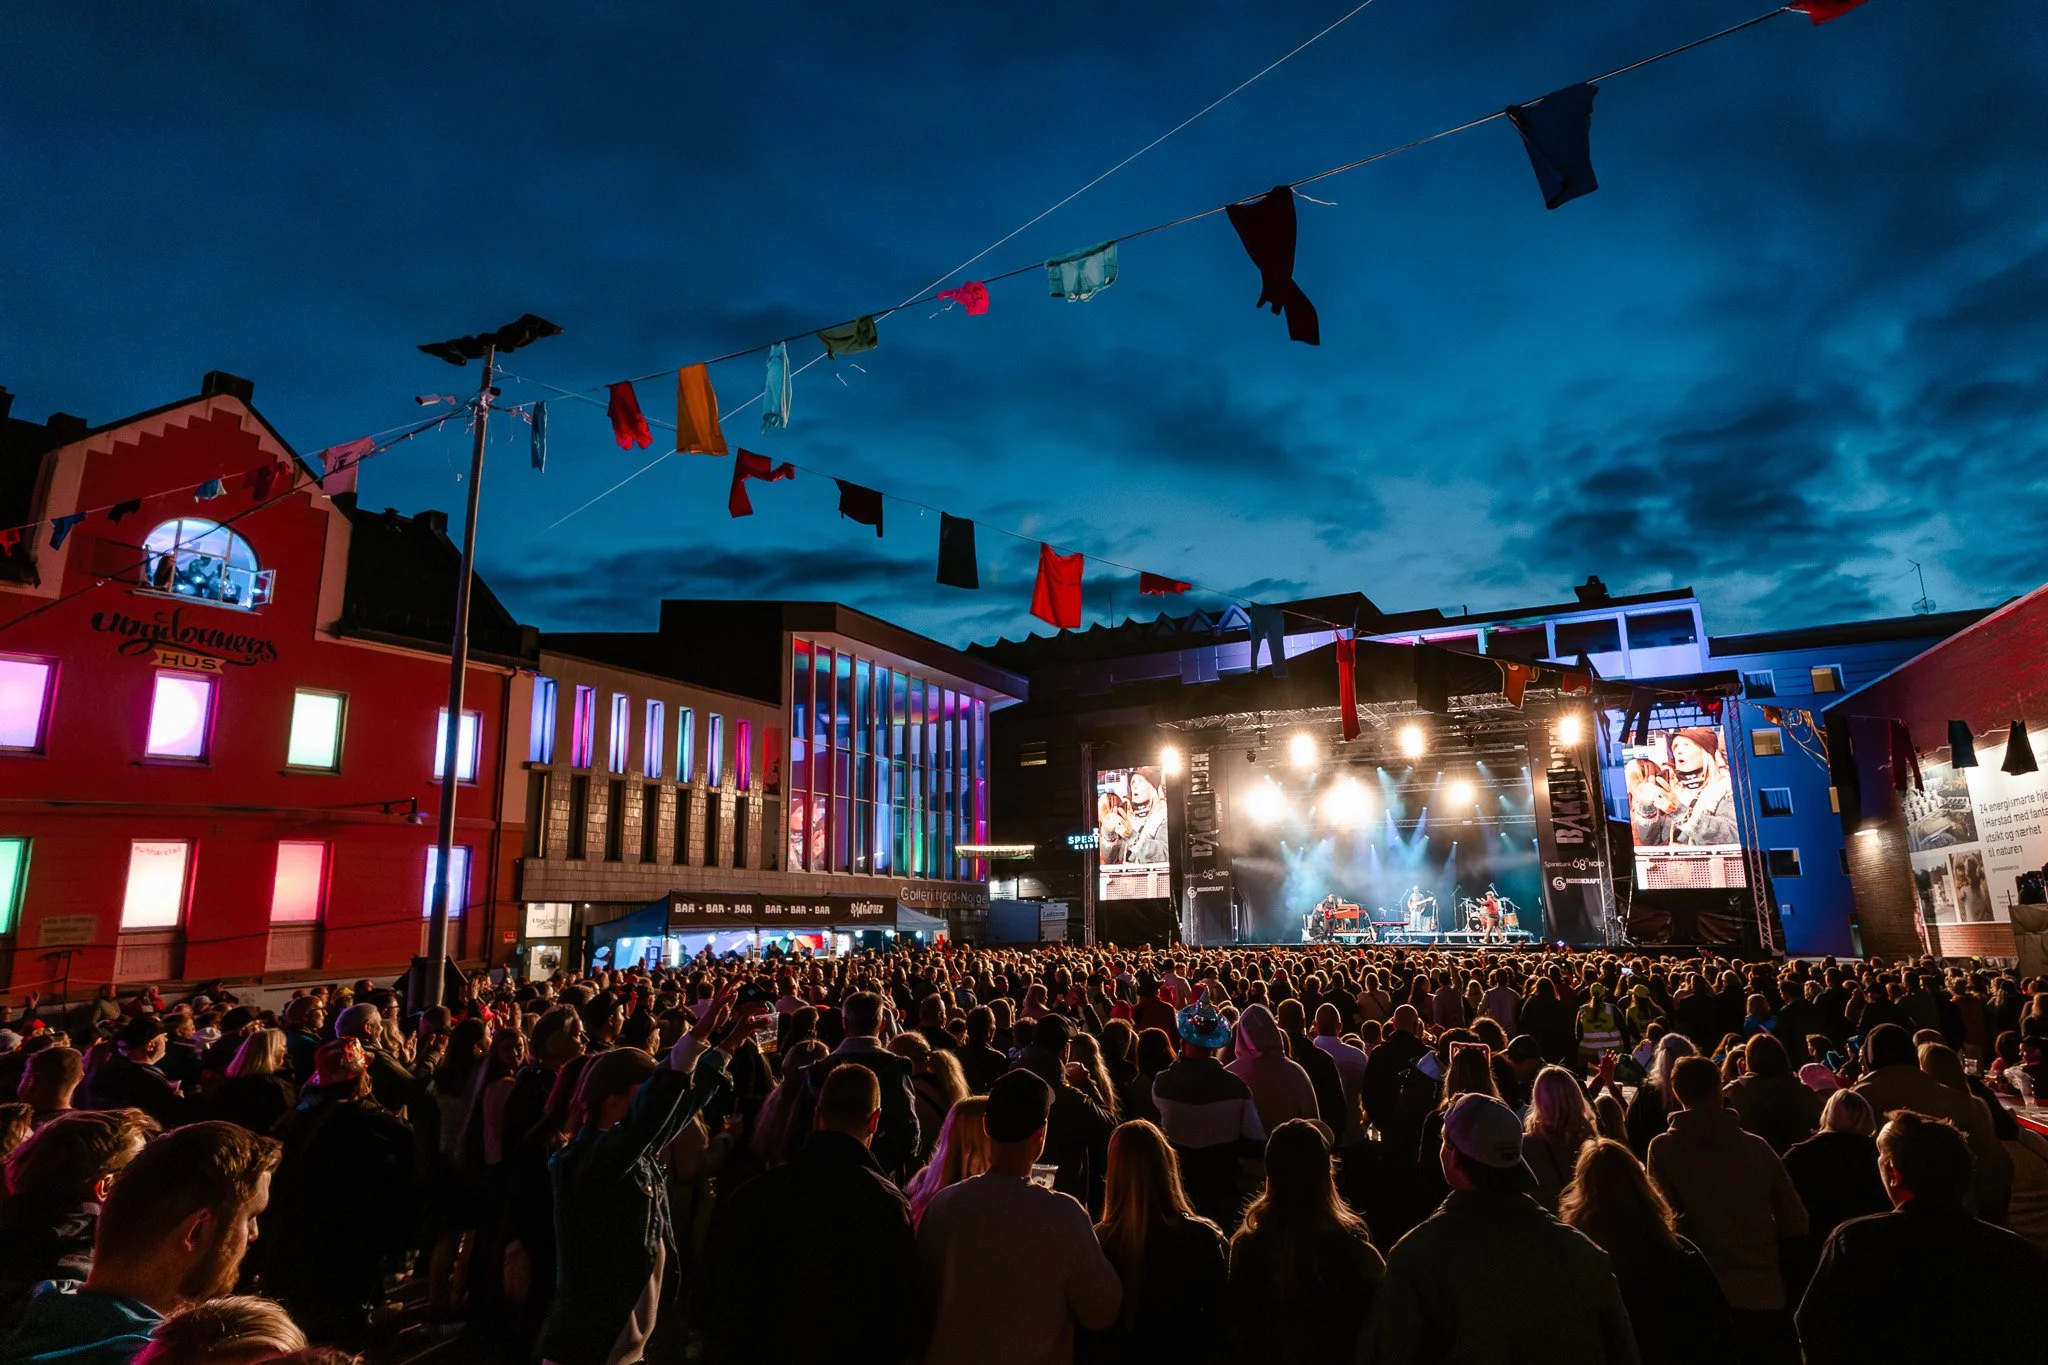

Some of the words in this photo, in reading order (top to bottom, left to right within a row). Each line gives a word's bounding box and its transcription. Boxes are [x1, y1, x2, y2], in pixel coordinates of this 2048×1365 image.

[161, 653, 217, 670] HUS
[1549, 727, 1591, 843] BAKGRD
[1979, 803, 1988, 814] 24
[1989, 794, 2036, 811] energismarte
[1985, 813, 2012, 828] Harstad
[2014, 809, 2029, 821] med
[1985, 830, 2004, 843] utsikt
[2005, 830, 2014, 841] og
[2015, 824, 2042, 837] nærhet
[1996, 845, 2023, 857] naturen
[900, 886, 933, 901] Galleri
[935, 889, 987, 905] Nord-Norge
[675, 903, 695, 913] BAR
[706, 904, 725, 913] BAR
[734, 904, 752, 913] BAR
[765, 904, 781, 914] BAR
[790, 905, 807, 914] BAR
[815, 906, 830, 915] BAR
